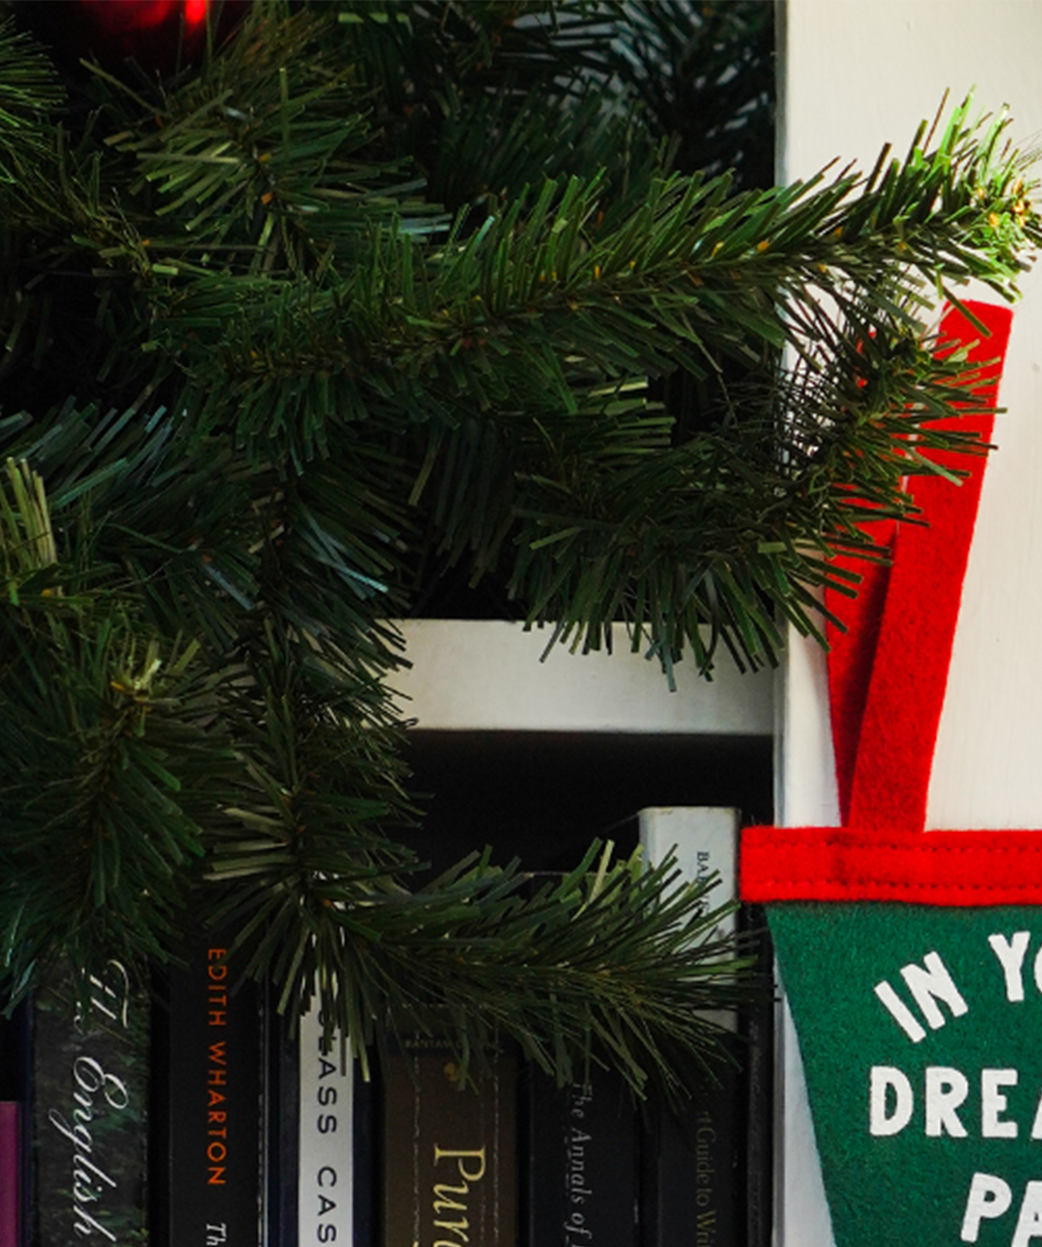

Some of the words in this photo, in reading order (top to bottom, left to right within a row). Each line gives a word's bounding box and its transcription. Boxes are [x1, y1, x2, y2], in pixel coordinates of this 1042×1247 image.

[208, 948, 227, 1026] EDITH
[874, 951, 969, 1043] IN
[49, 1056, 128, 1242] English
[207, 1040, 227, 1185] WHARTON
[571, 1128, 592, 1204] Annals
[695, 1126, 716, 1184] Guide
[563, 1212, 592, 1239] of
[695, 1188, 713, 1207] to
